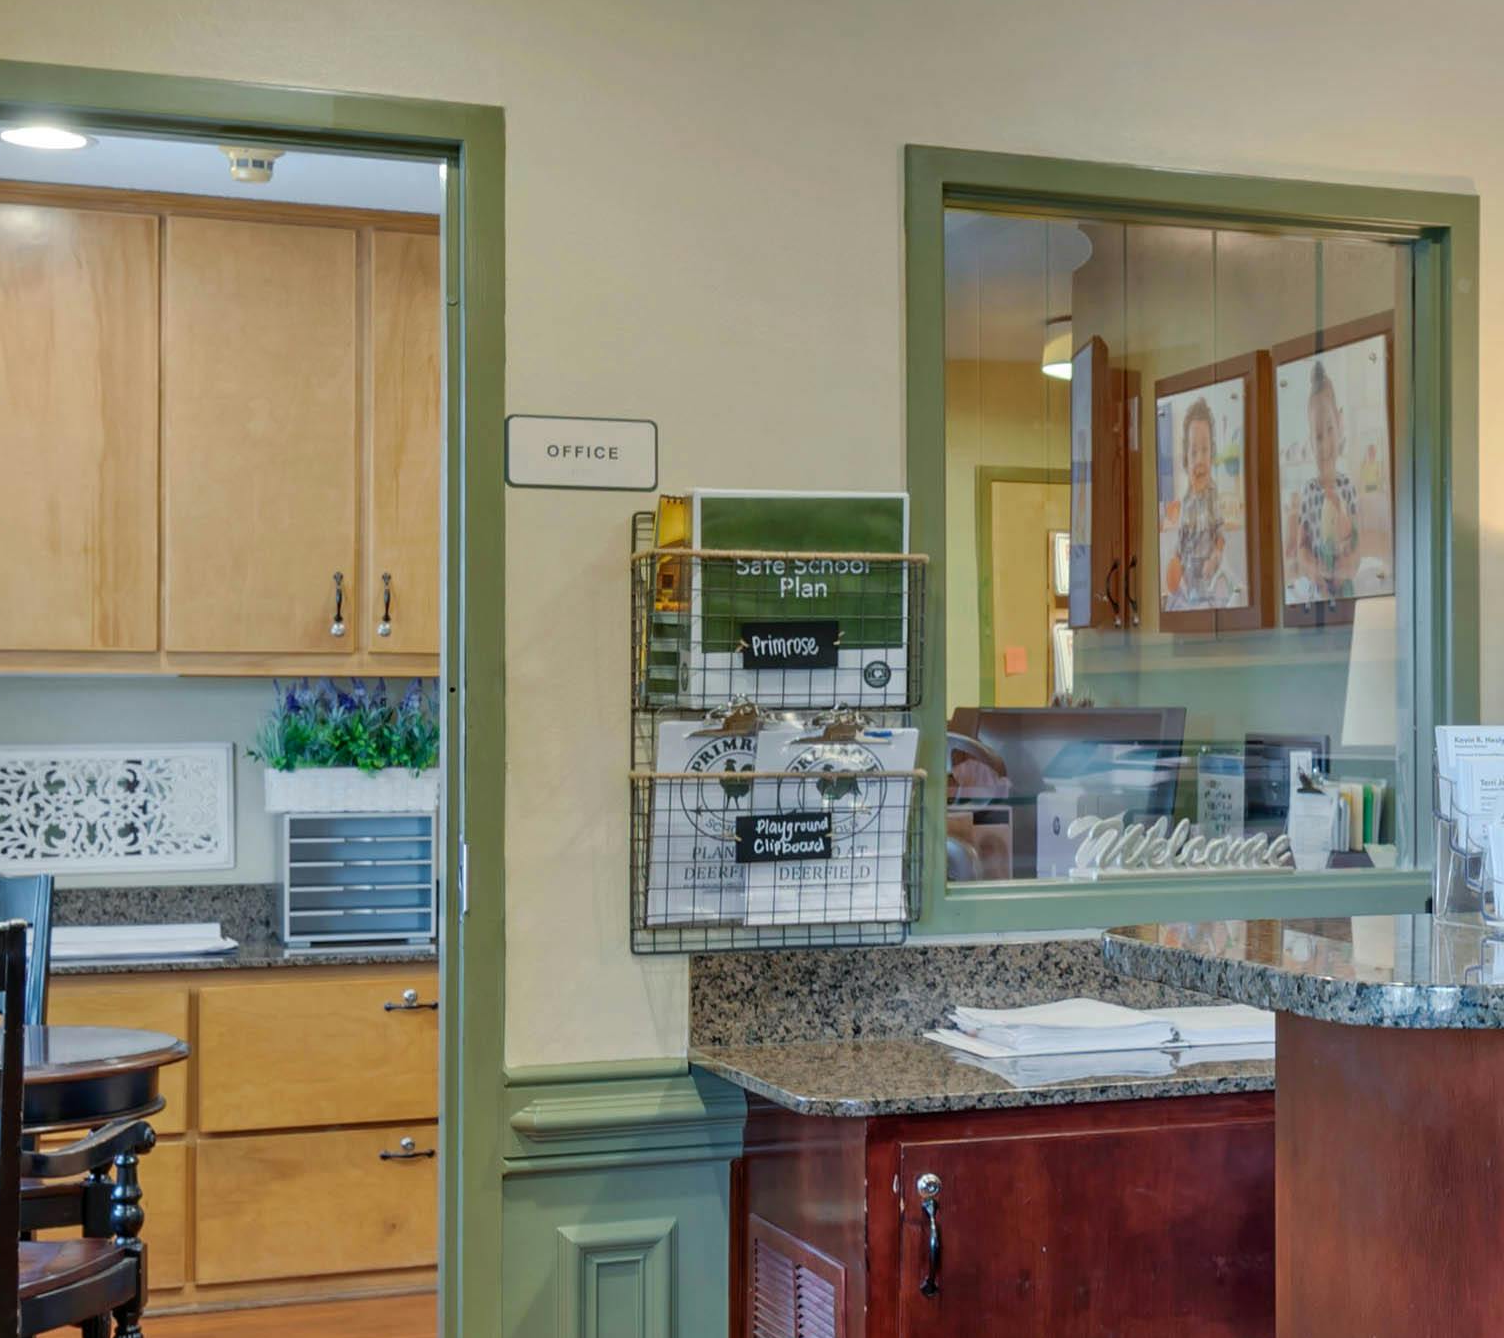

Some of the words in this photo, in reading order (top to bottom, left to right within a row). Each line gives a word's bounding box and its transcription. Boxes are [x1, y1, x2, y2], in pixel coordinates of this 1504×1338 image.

[547, 444, 619, 460] OFFICE
[736, 558, 786, 575] Safe
[794, 558, 871, 575] School
[779, 575, 828, 598] Plan
[751, 634, 819, 658] Primrose
[690, 736, 758, 773] PRIMR
[755, 816, 829, 843] Playground
[753, 837, 825, 857] Clipboard
[1068, 814, 1294, 870] Welcome
[692, 845, 736, 860] PLAN
[683, 865, 745, 881] DEERFI
[778, 865, 871, 881] DEERFIELD
